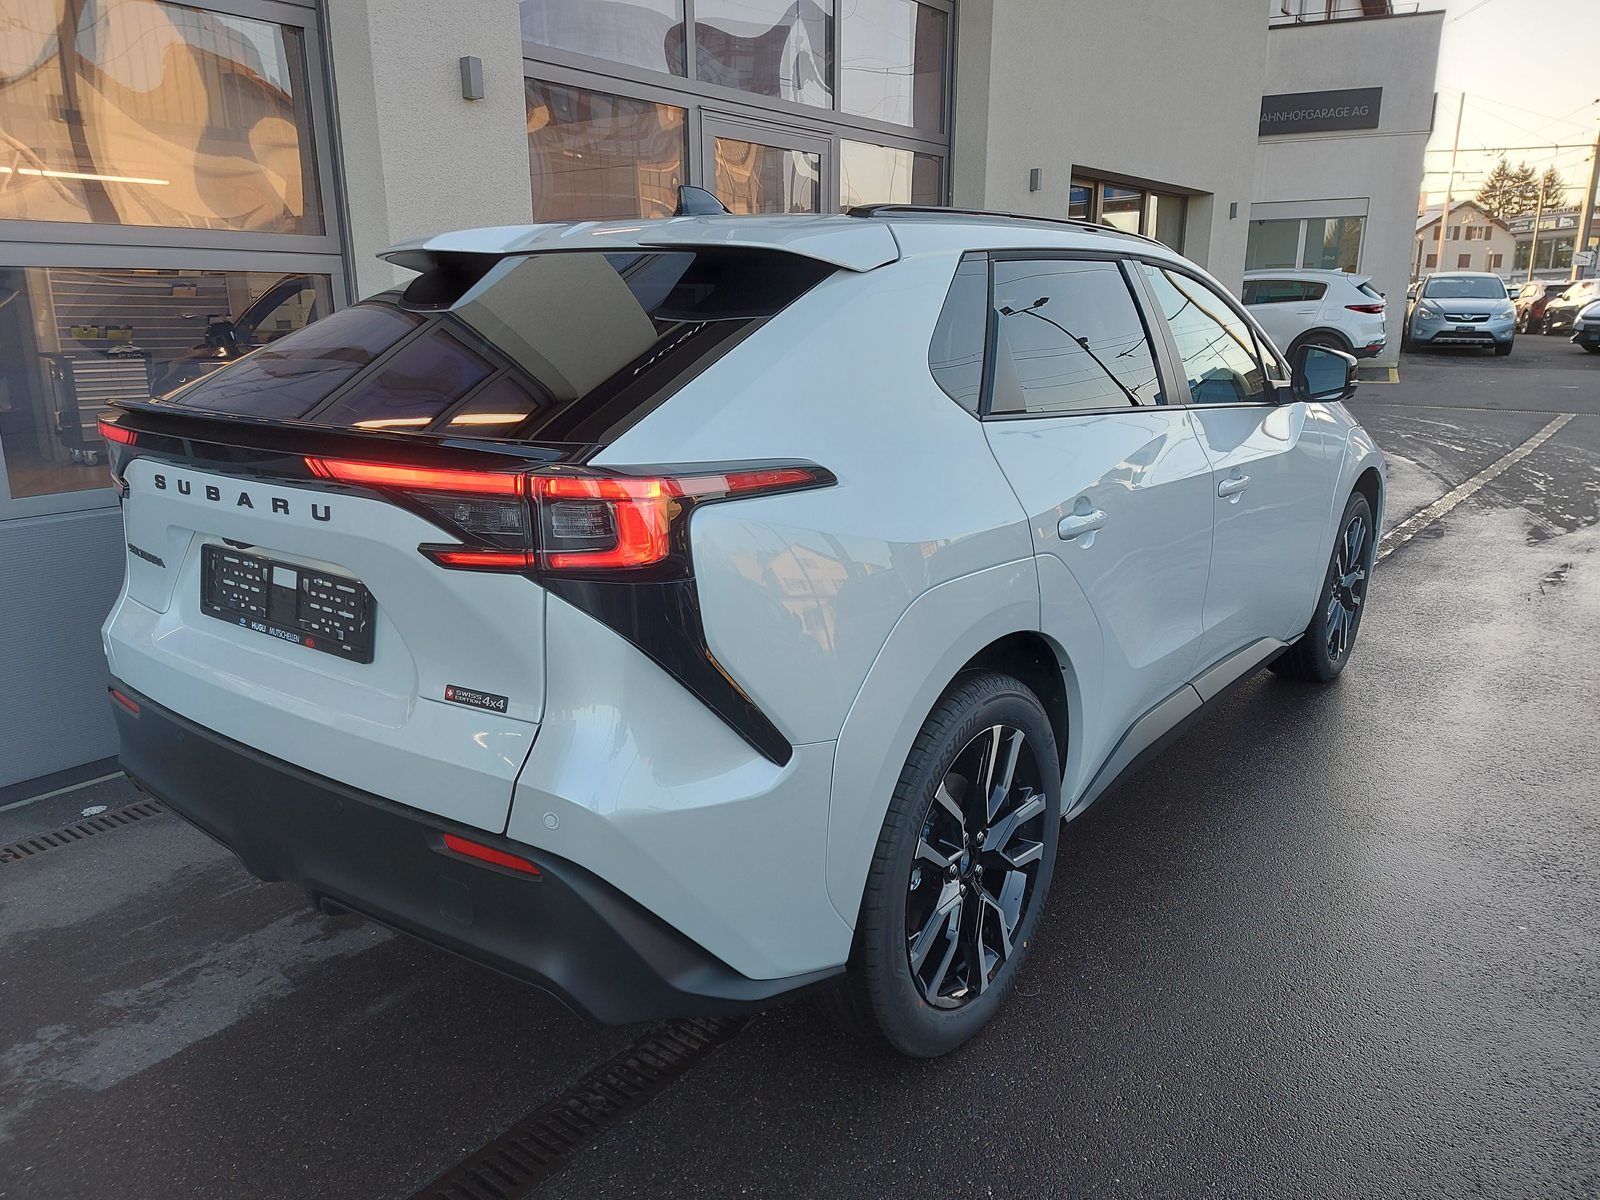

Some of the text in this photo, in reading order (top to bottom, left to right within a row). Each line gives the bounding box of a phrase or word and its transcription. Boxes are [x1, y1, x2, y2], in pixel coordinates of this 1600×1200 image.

[1261, 105, 1369, 122] AHNHOFGARAGE AG
[154, 474, 332, 522] SUBARU
[455, 689, 483, 700] SWISS
[455, 695, 482, 705] EDITION
[482, 696, 505, 710] 4x4
